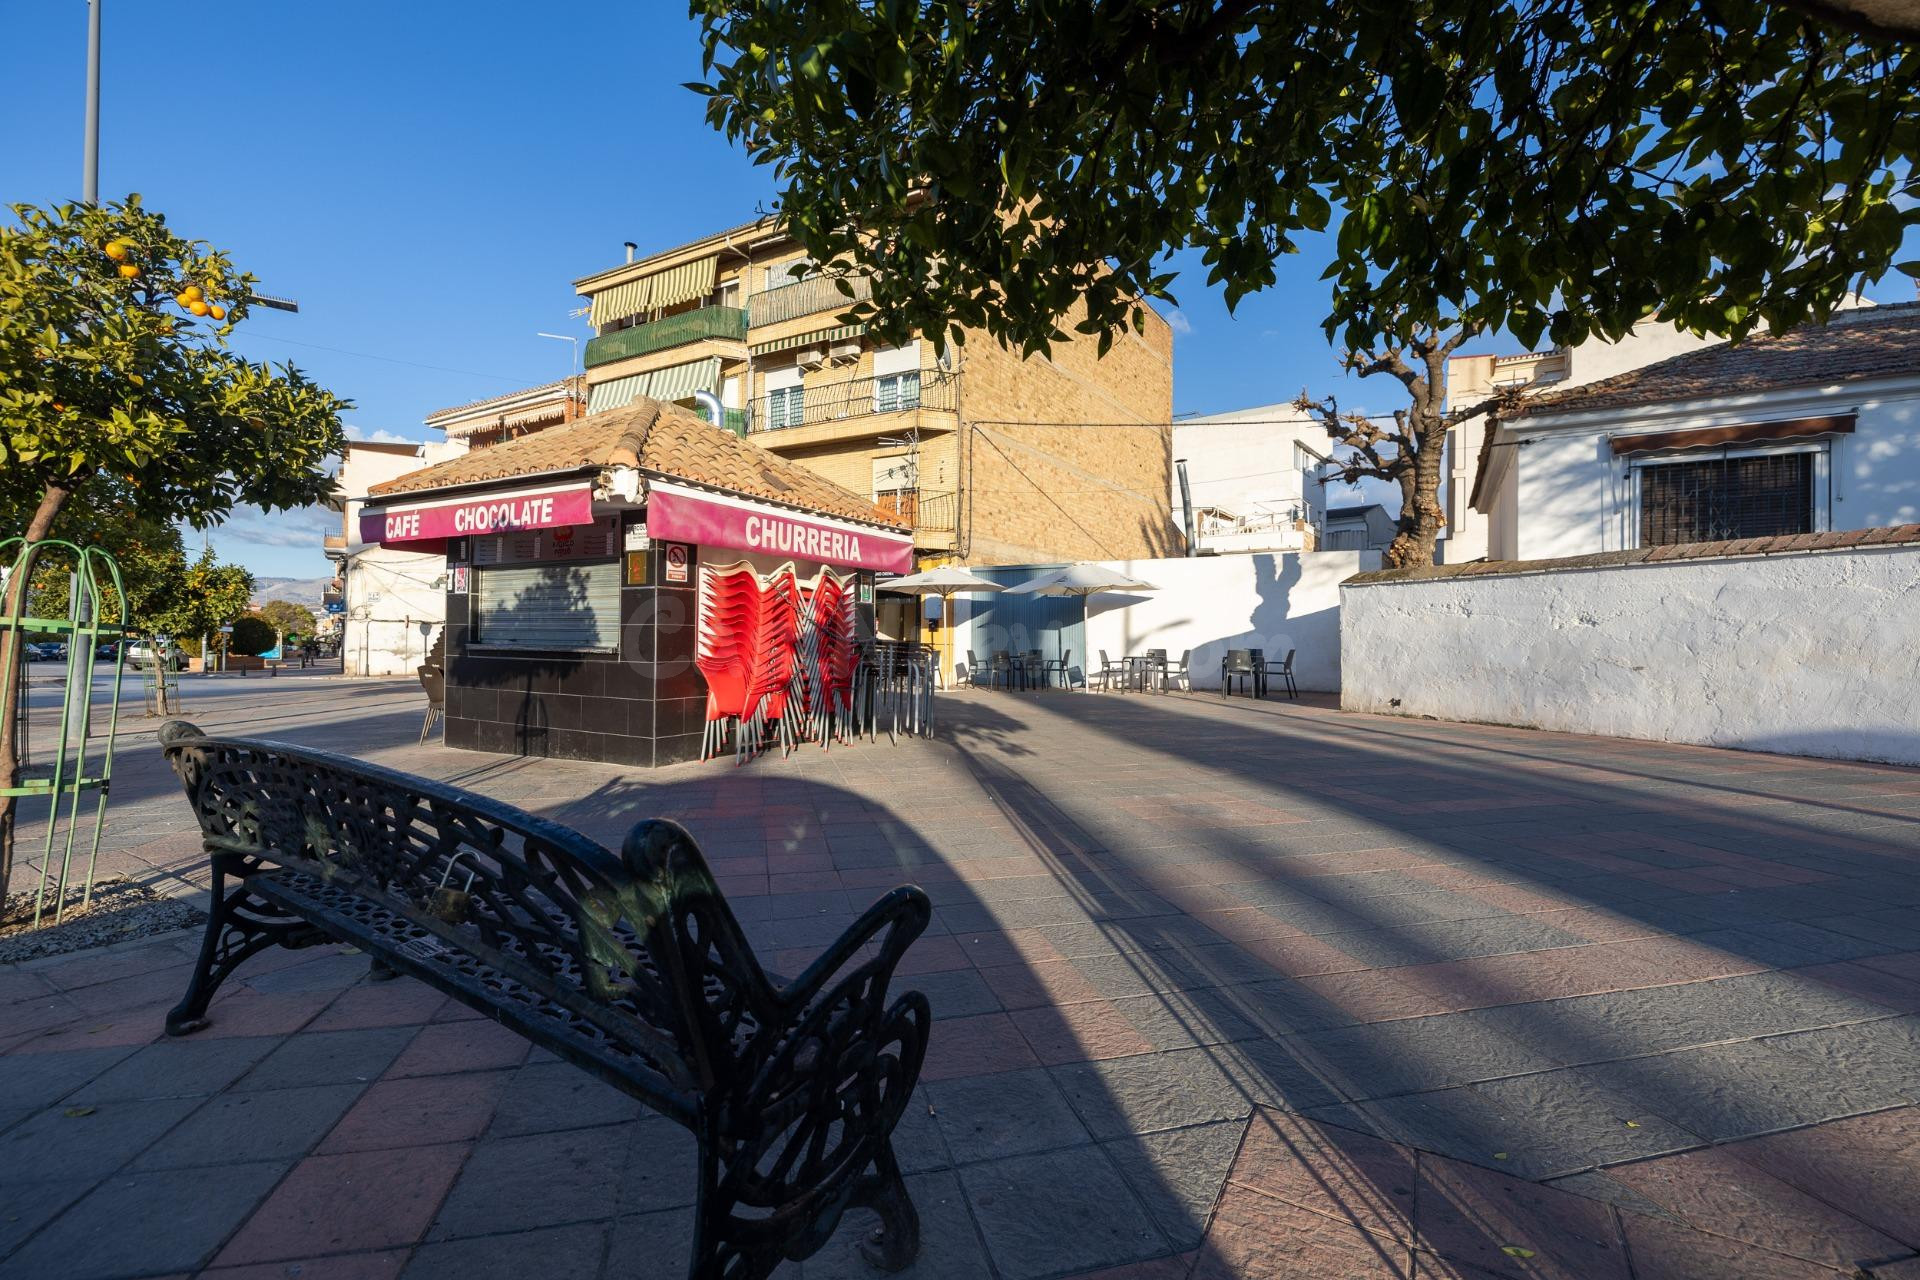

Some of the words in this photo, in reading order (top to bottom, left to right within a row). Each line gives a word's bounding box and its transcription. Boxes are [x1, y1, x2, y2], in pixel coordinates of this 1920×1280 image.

[385, 510, 420, 539] CAFÉ
[454, 498, 553, 532] CHOCOLATE
[745, 516, 862, 562] CHURRERIA
